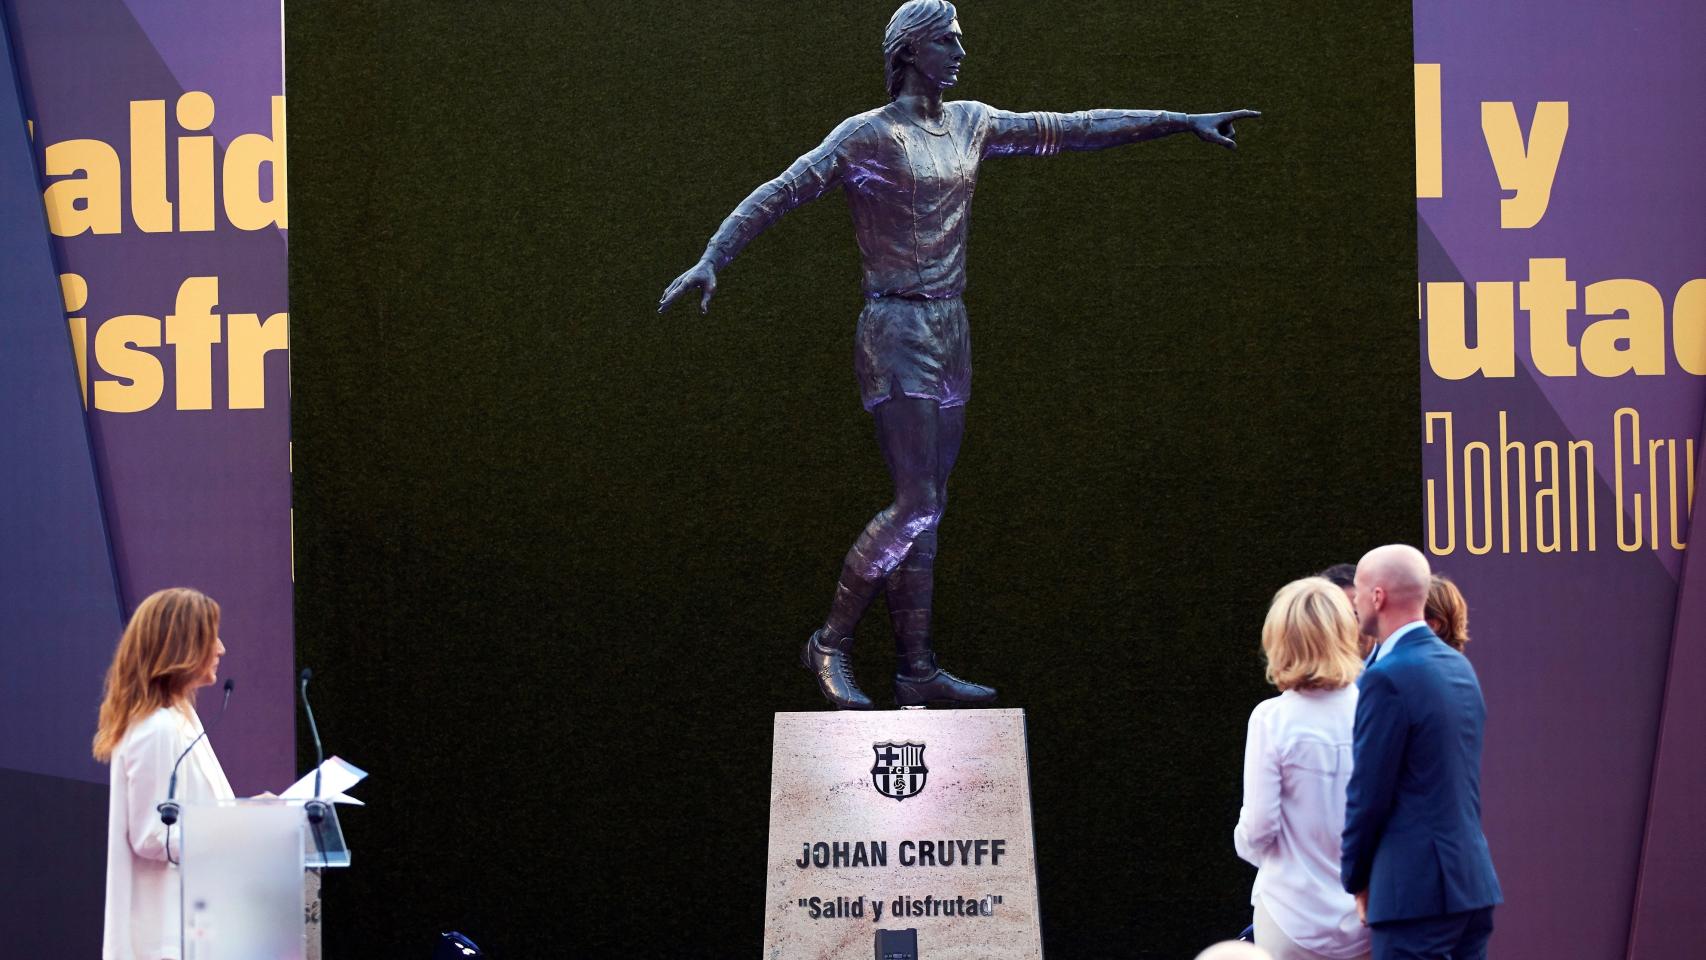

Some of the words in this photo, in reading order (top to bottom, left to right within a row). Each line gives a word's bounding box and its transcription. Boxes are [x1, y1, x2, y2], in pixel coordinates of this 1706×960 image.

[28, 91, 289, 237] alid
[1481, 101, 1569, 229] y
[1418, 257, 1706, 380] uta
[1425, 410, 1596, 556] Johan
[889, 766, 911, 774] FCB
[796, 840, 887, 868] JOHAN
[899, 839, 1006, 867] CRUYFF
[798, 896, 864, 919] "Salid
[871, 899, 884, 923] y
[891, 894, 1003, 917] disfrutad"
